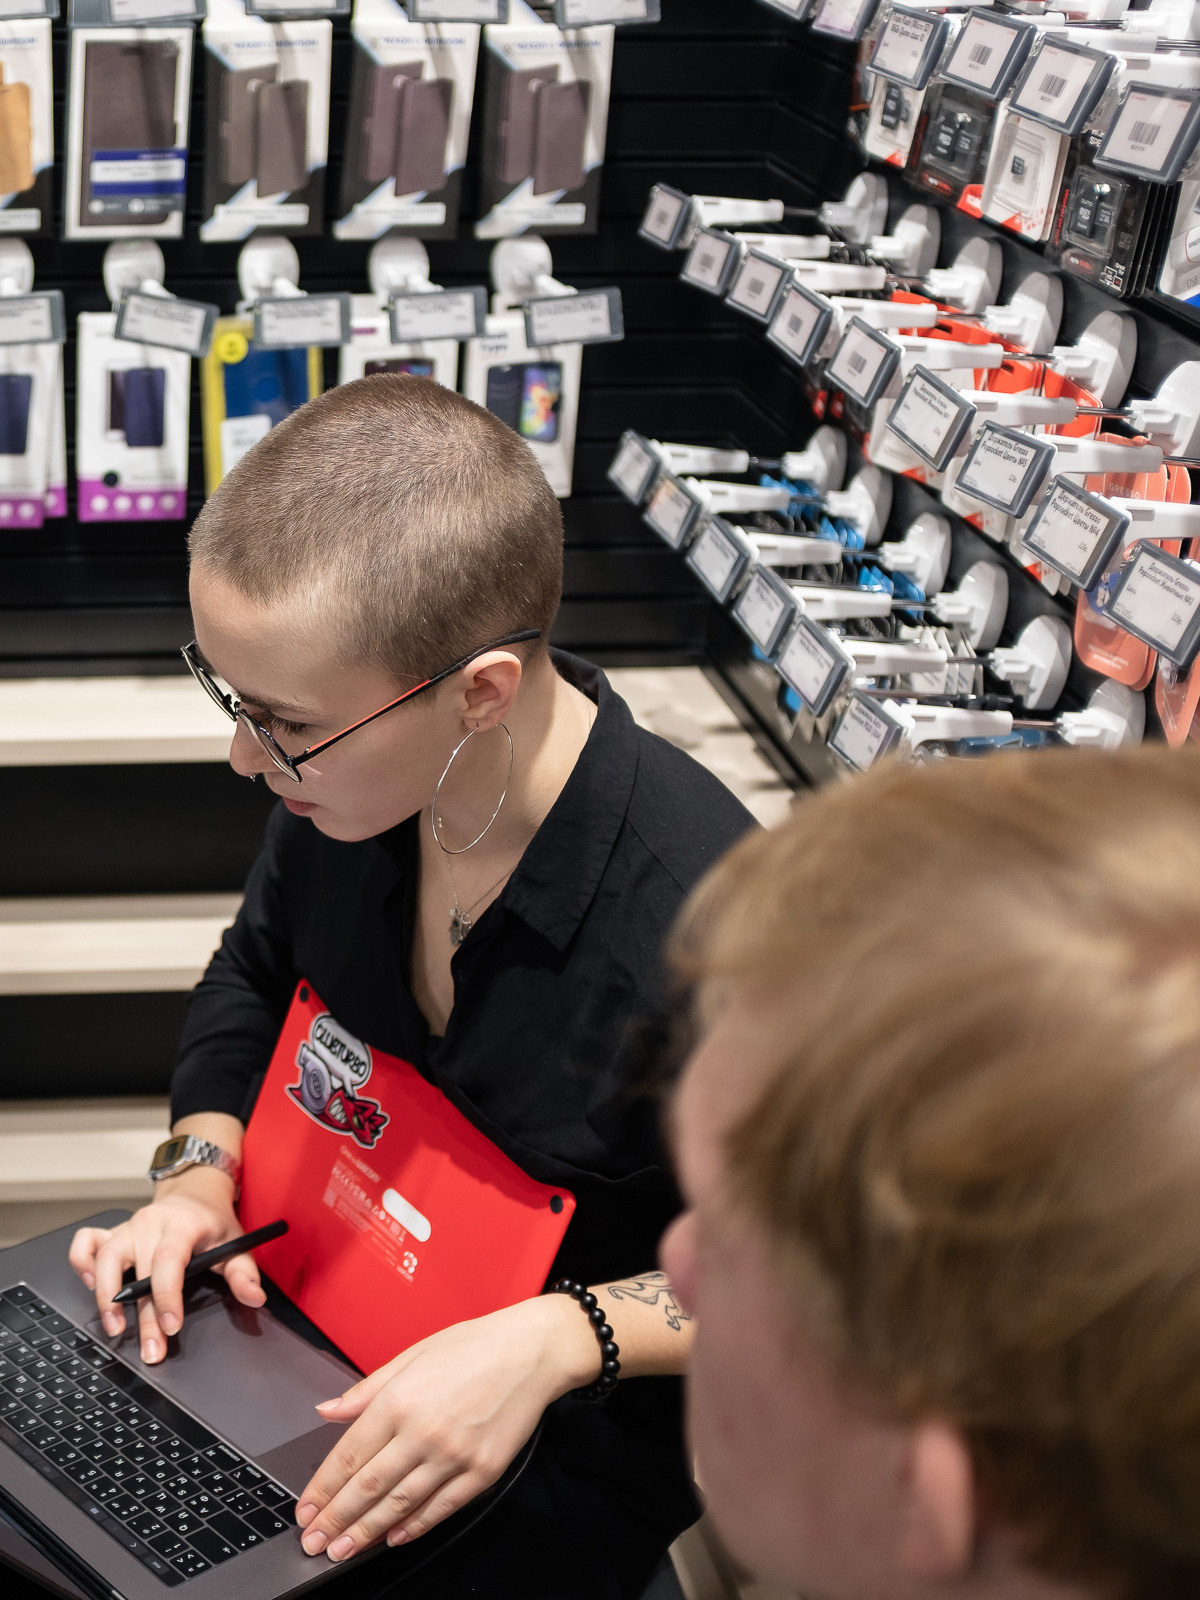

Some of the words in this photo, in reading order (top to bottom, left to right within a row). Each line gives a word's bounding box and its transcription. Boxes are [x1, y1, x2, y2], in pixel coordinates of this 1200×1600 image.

[980, 440, 1004, 456] Popsocket
[1002, 450, 1018, 463] Цветы
[987, 432, 1013, 449] Держатель
[1011, 443, 1028, 456] Gresso
[1050, 498, 1074, 519] Popsocket
[1072, 514, 1088, 530] Цветы
[1088, 524, 1100, 536] №4
[1057, 490, 1085, 512] Держатель
[1083, 507, 1101, 524] Gresso
[1138, 566, 1161, 585] Popsocket
[1148, 562, 1174, 582] Держатель
[1173, 577, 1189, 592] Gresso
[316, 1023, 367, 1077] CLUBTURBO
[218, 1445, 240, 1461] command
